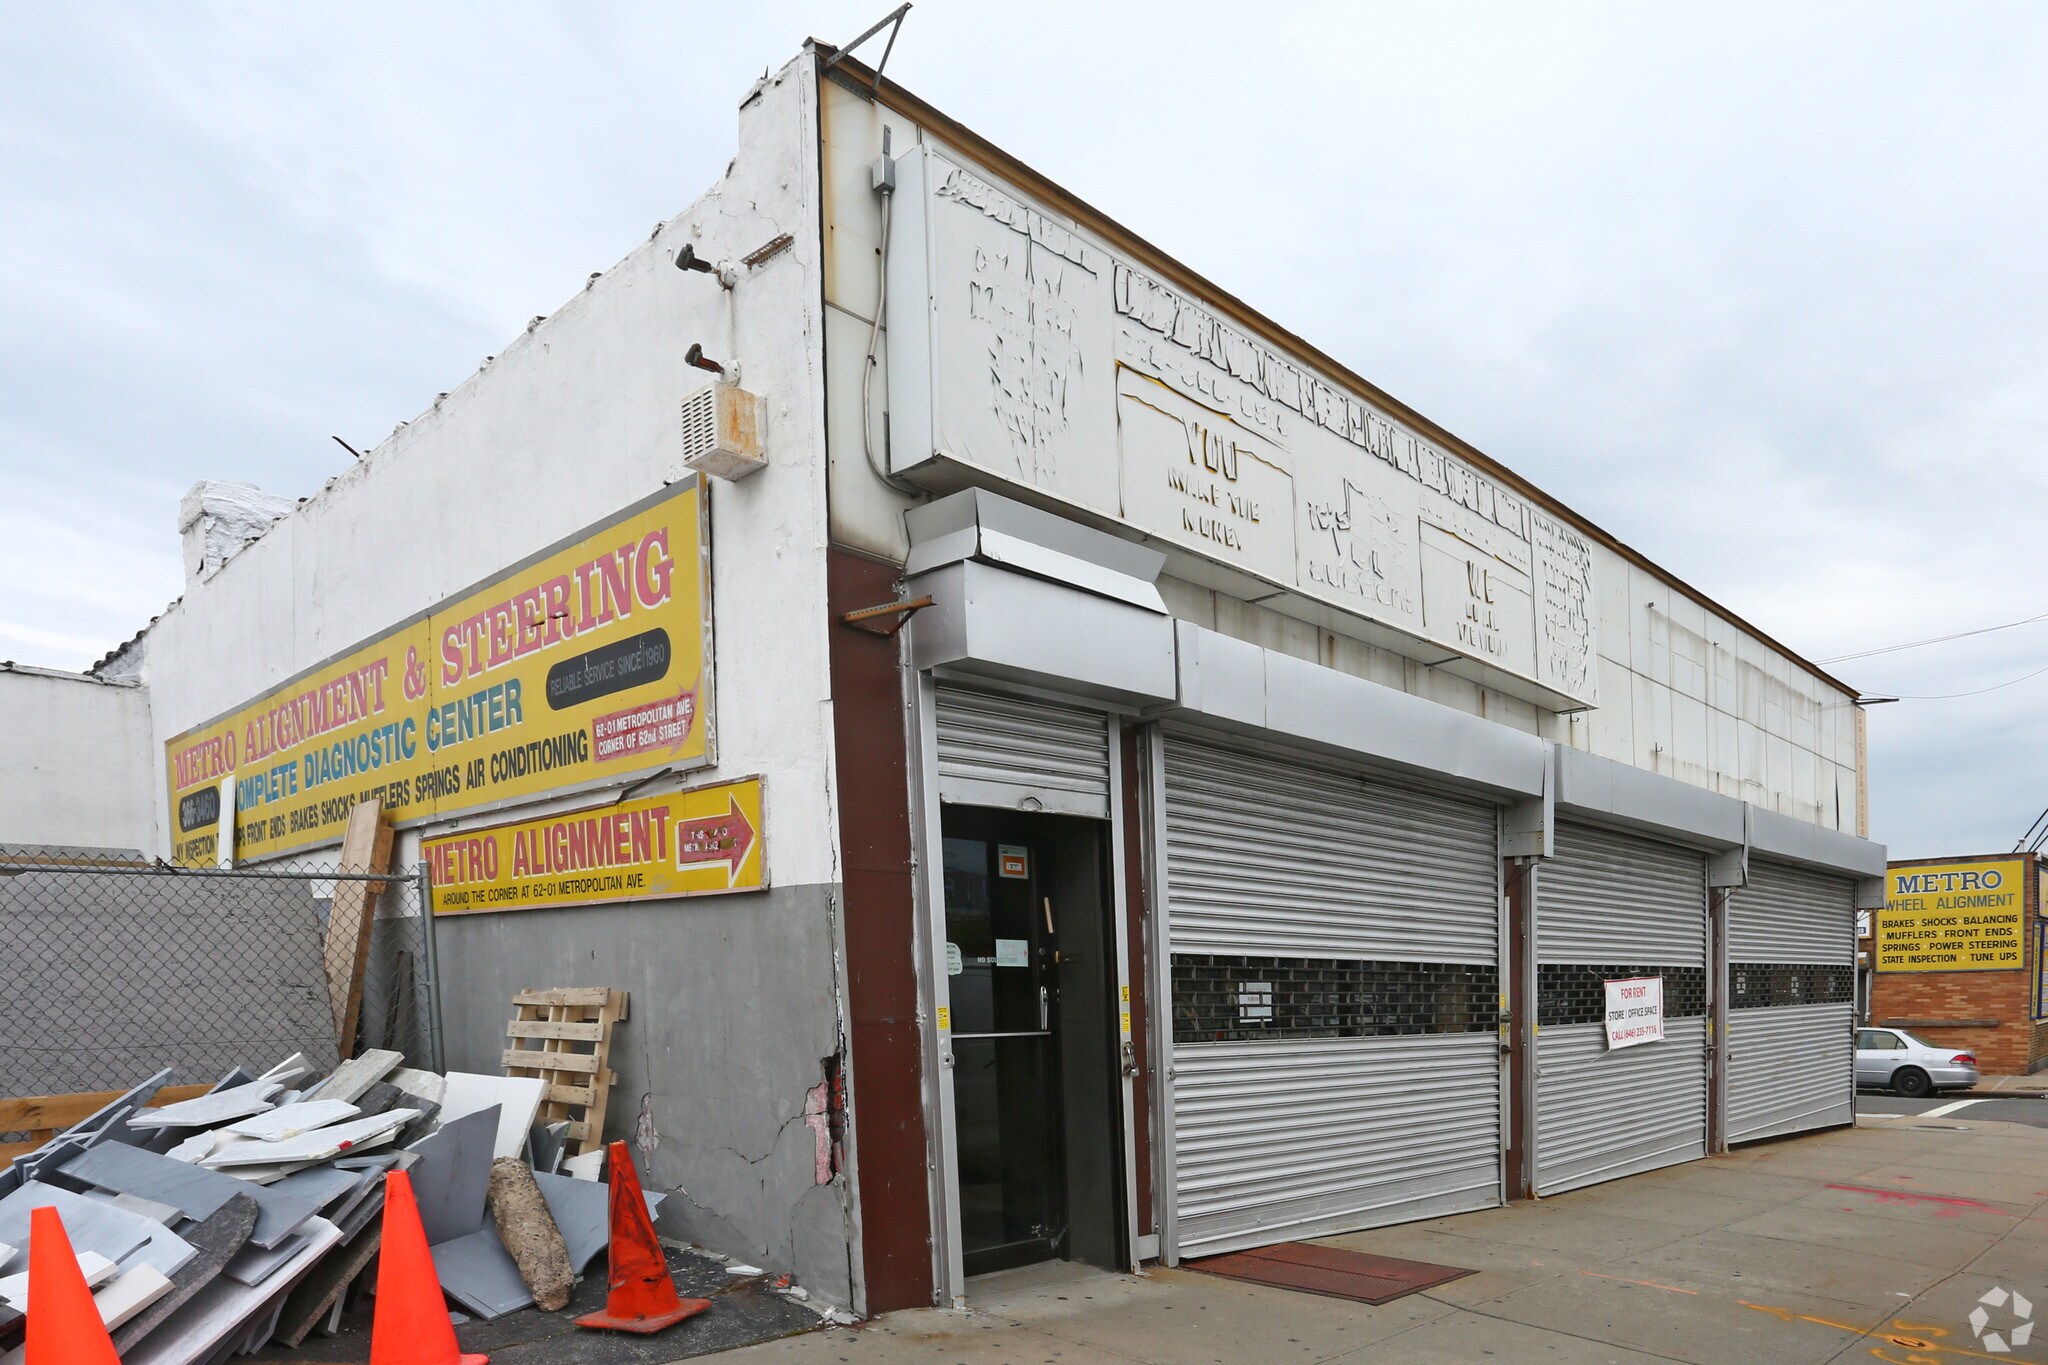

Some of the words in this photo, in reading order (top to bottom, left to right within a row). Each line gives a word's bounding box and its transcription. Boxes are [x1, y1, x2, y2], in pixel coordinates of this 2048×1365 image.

[174, 730, 237, 791] METRO
[243, 656, 388, 767] ALIGNMENT
[403, 645, 427, 701] &
[440, 526, 675, 688] STEERING
[550, 671, 582, 697] RELIABLE
[584, 660, 615, 687] SERVICE
[617, 651, 641, 676] SINCE
[643, 643, 666, 667] 1960
[595, 721, 616, 738] 62-01
[616, 704, 673, 732] METROPOLITAN
[676, 698, 693, 717] AVE.
[236, 760, 298, 813] OMPLETE
[304, 717, 417, 791] DIAGNOSTIC
[426, 678, 523, 753] CENTER
[598, 738, 625, 756] CORNER
[627, 734, 636, 749] OF
[638, 728, 657, 747] 62nd
[659, 719, 687, 741] STREET
[246, 819, 267, 845] FRONT
[270, 813, 286, 840] ENDS
[289, 804, 319, 833] BRAKES
[321, 793, 355, 825] SHOCKS
[415, 764, 460, 804] SPRINGS
[466, 757, 486, 791] AIR
[490, 728, 588, 784] CONDITIONING
[185, 834, 215, 860] INSPECTION
[424, 834, 499, 889] METRO
[511, 805, 670, 880] ALIGNMENT
[443, 891, 470, 906] AROUND
[472, 890, 485, 903] THE
[488, 887, 518, 902] CORNER
[521, 885, 530, 898] AT
[533, 883, 557, 898] 62-01
[558, 875, 623, 896] METROPOLITAN
[626, 873, 646, 889] AVE.
[1896, 869, 2004, 895] METRO
[1885, 898, 1928, 912] WHEEL
[1936, 893, 2015, 910] ALIGNMENT
[1881, 918, 1915, 929] BRAKES
[1921, 917, 1957, 927] SHOCKS
[1963, 914, 2018, 925] BALANCING
[1886, 930, 1937, 941] MUFFLERS
[1944, 928, 1980, 938] FRONT
[1985, 927, 2013, 937] ENDS
[1881, 942, 1921, 953] SPRINGS
[1929, 941, 1964, 951] POWER
[1968, 939, 2018, 950] STEERING
[1881, 954, 1904, 965] STATE
[1908, 953, 1957, 964] INSPECTION
[1970, 952, 1995, 963] TUNE
[1999, 951, 2018, 962] UPS
[977, 956, 986, 964] NO
[1620, 987, 1633, 999] FOR
[1633, 986, 1647, 998] RENT
[1608, 1009, 1625, 1021] STORE
[1627, 1007, 1644, 1019] OFFICE
[1644, 1005, 1658, 1017] SPACE
[1611, 1030, 1624, 1041] CALL
